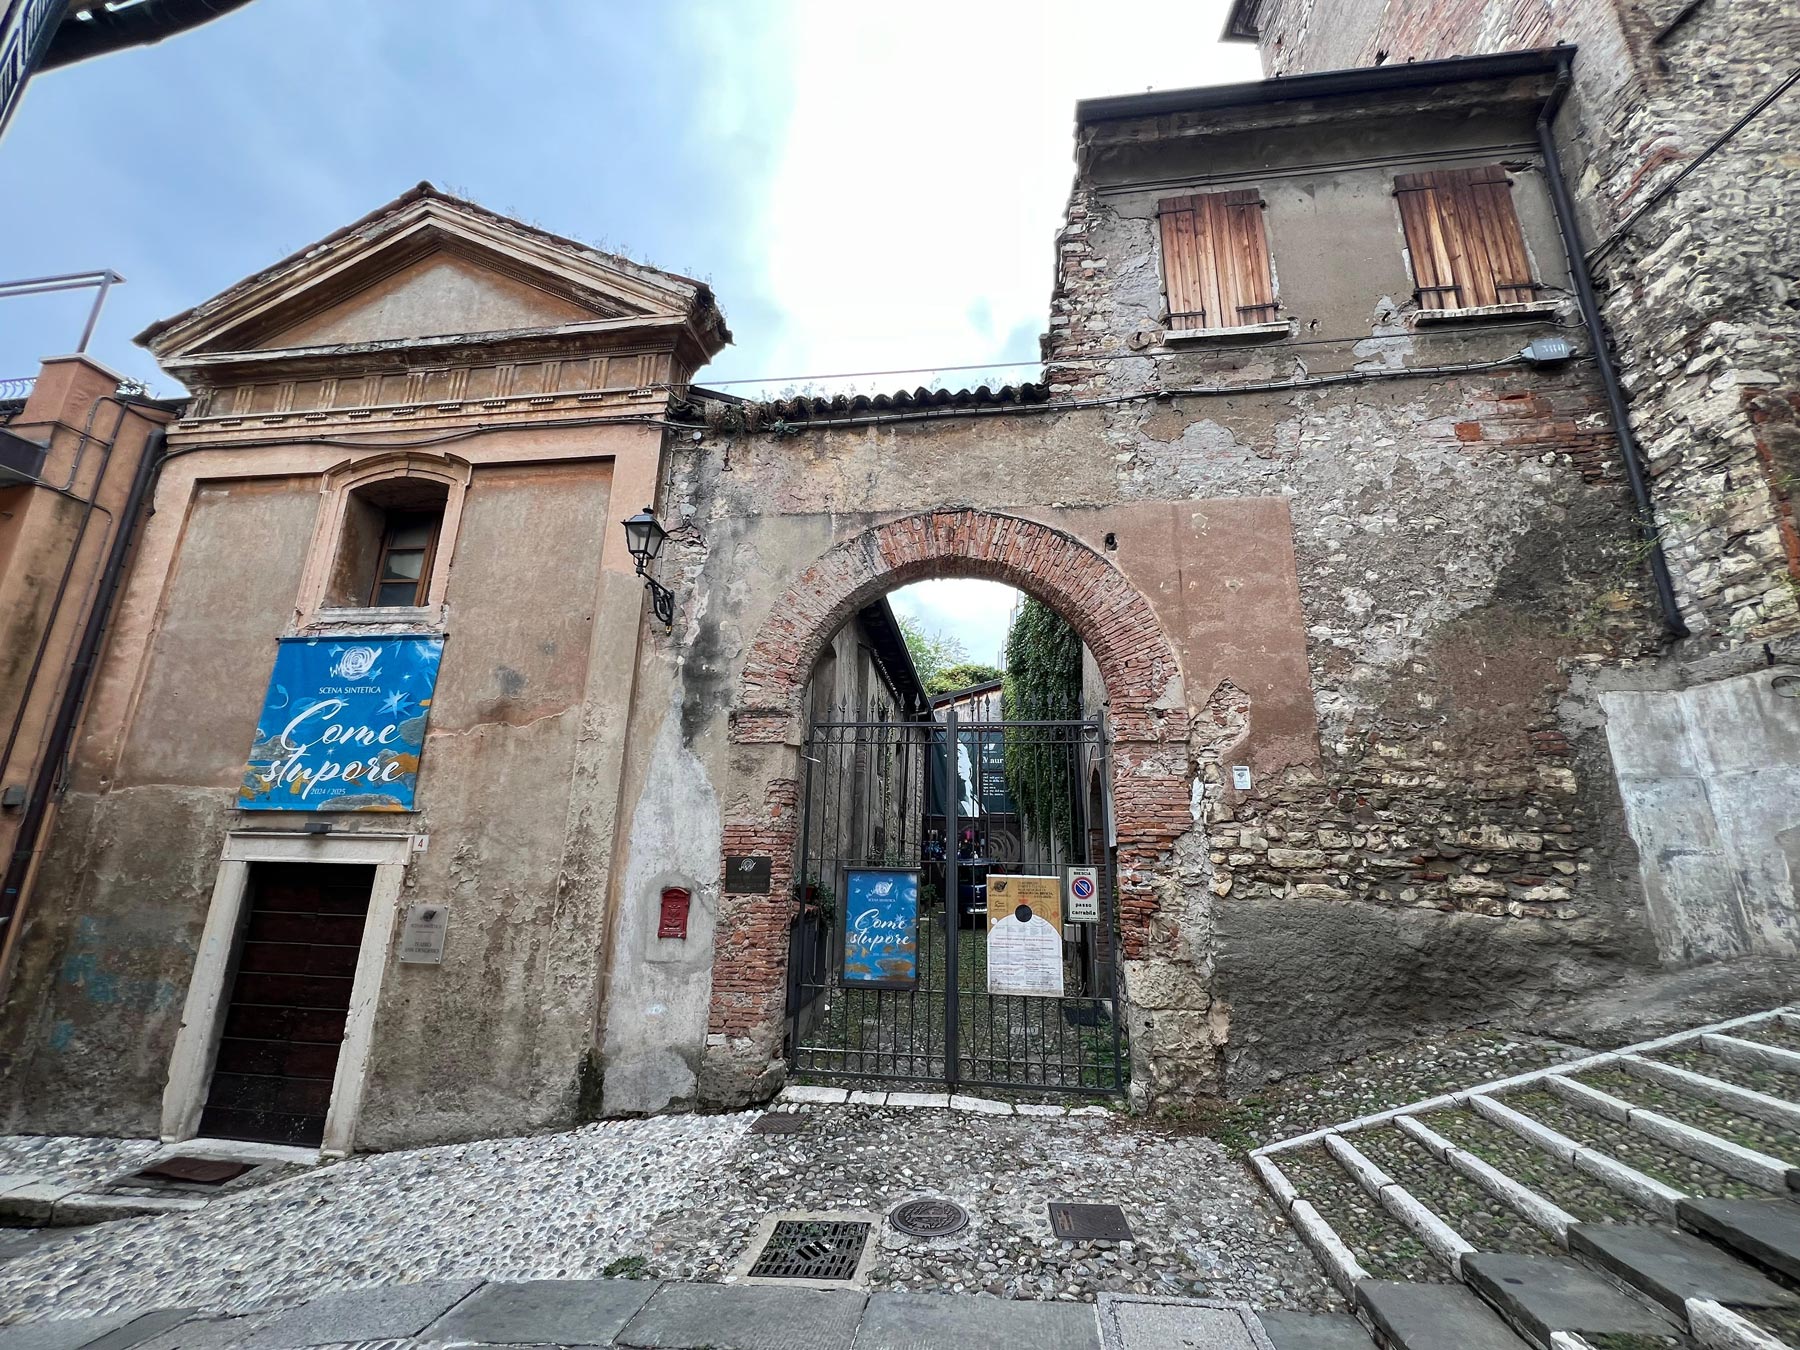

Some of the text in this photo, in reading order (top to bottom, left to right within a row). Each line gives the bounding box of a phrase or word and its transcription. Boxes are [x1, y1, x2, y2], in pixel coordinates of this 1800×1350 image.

[319, 686, 381, 695] SCENA SINTETICA
[280, 699, 401, 751] Come
[261, 743, 405, 800] stupore
[330, 787, 346, 795] 2025
[418, 838, 424, 848] 4
[855, 909, 907, 931] Come
[850, 928, 911, 952] stupore
